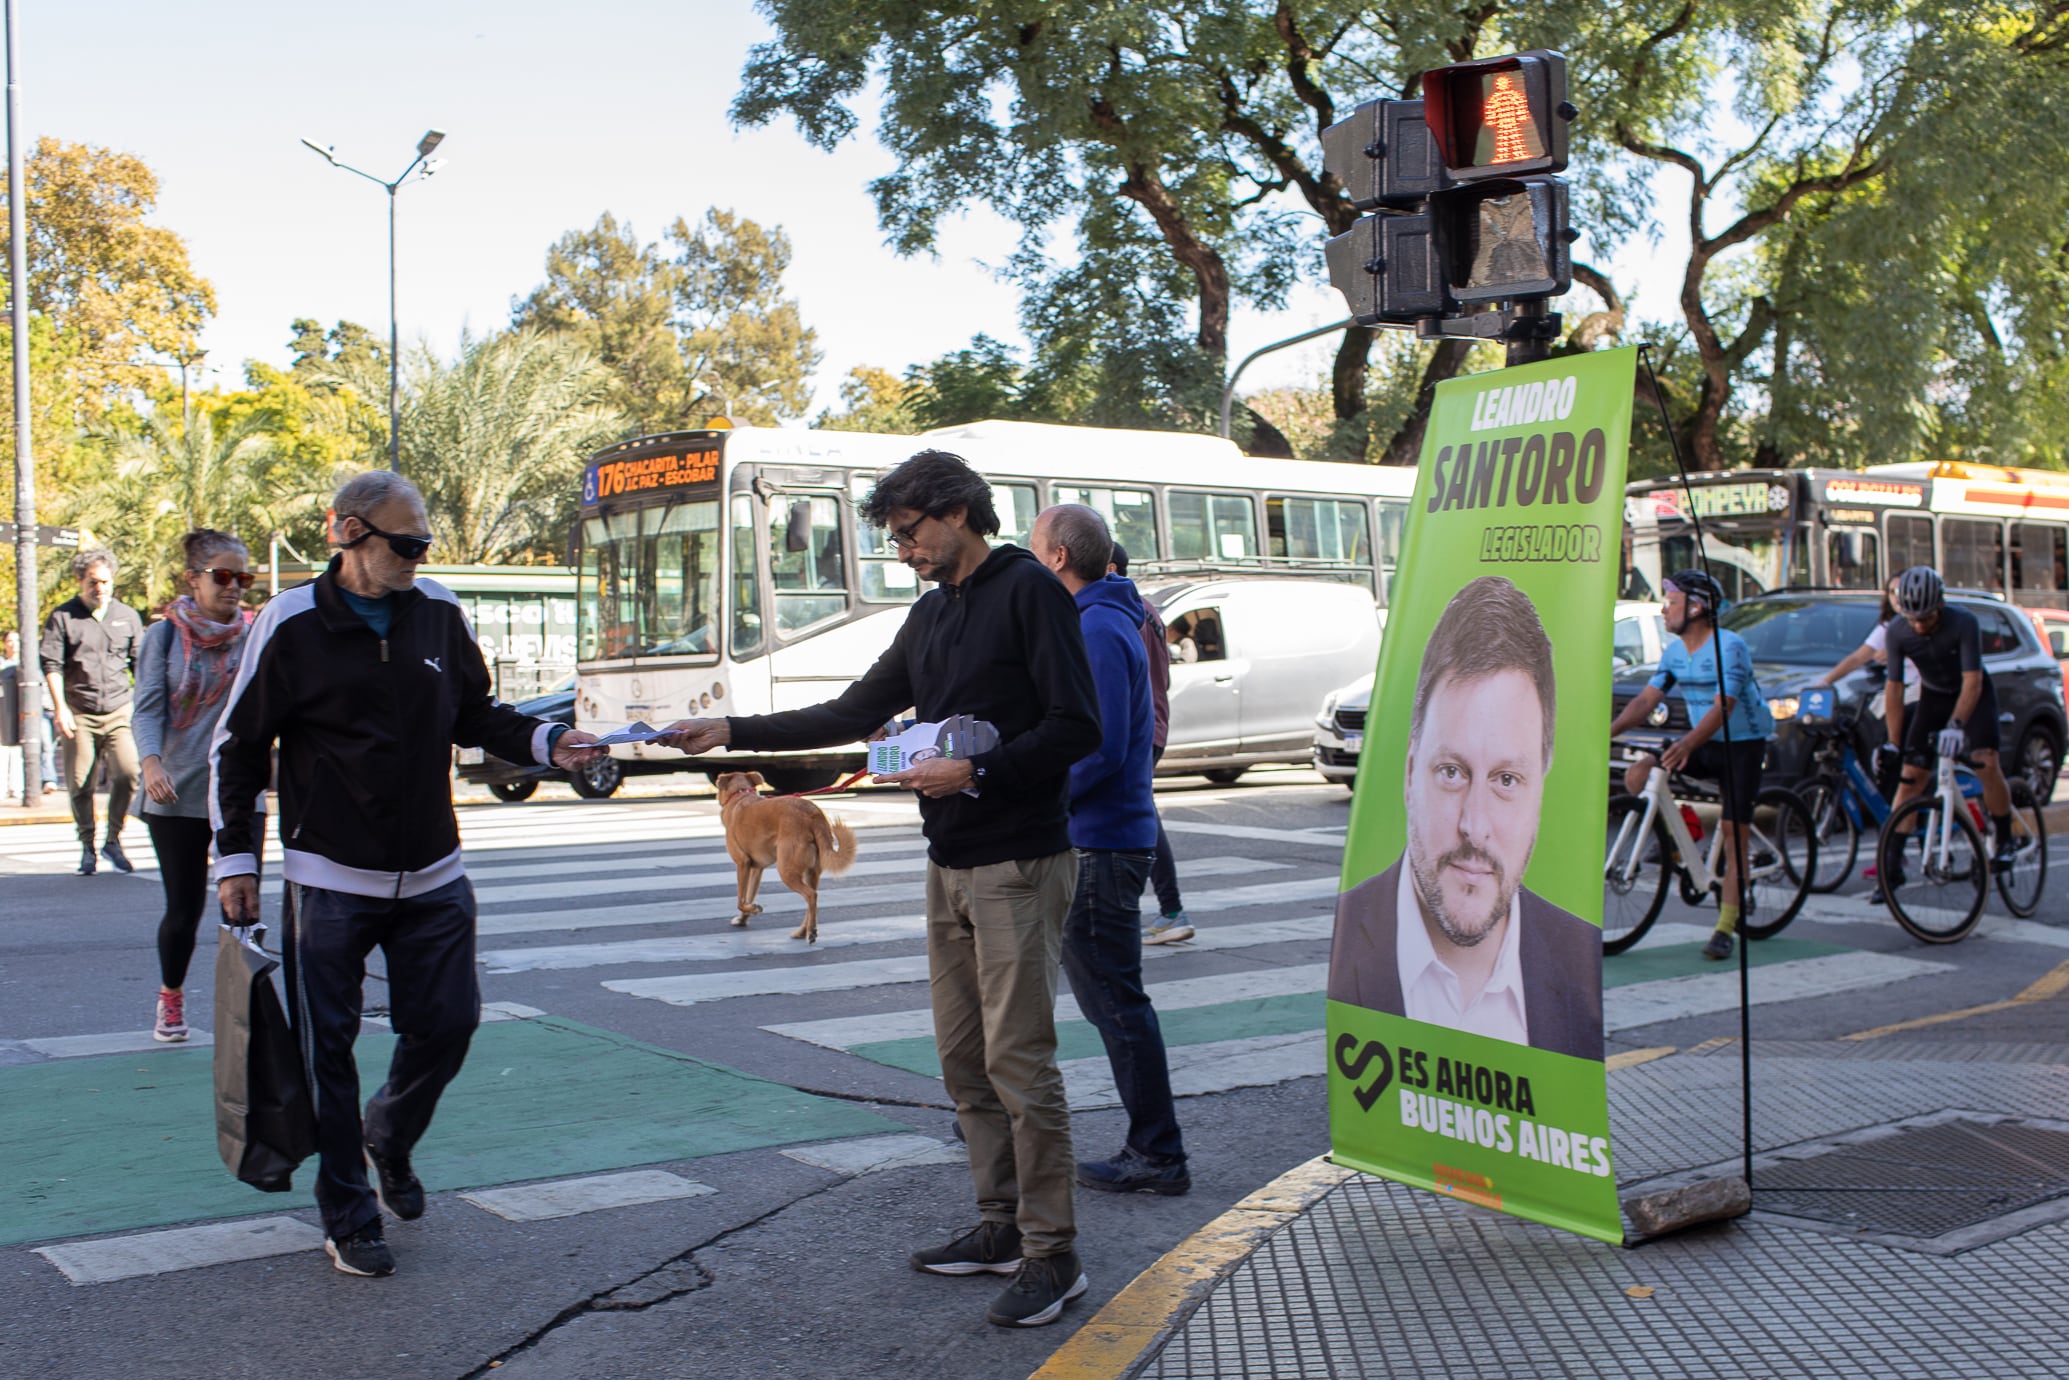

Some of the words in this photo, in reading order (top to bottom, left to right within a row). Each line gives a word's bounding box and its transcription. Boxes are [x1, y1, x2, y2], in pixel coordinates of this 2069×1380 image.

[1470, 376, 1577, 431] LEANDRO
[598, 461, 625, 497] 176
[685, 450, 719, 469] PILAR
[639, 473, 658, 488] PAZ
[664, 467, 715, 486] ESCOBAR
[1427, 427, 1606, 513] SANTORO
[1678, 483, 1768, 515] POMPEYA
[1479, 524, 1602, 563] LEGISLADOR
[1398, 1046, 1430, 1089] ES
[1436, 1057, 1537, 1118] AHORA
[1400, 1089, 1514, 1153] BUENOS
[1518, 1120, 1611, 1178] AIRES
